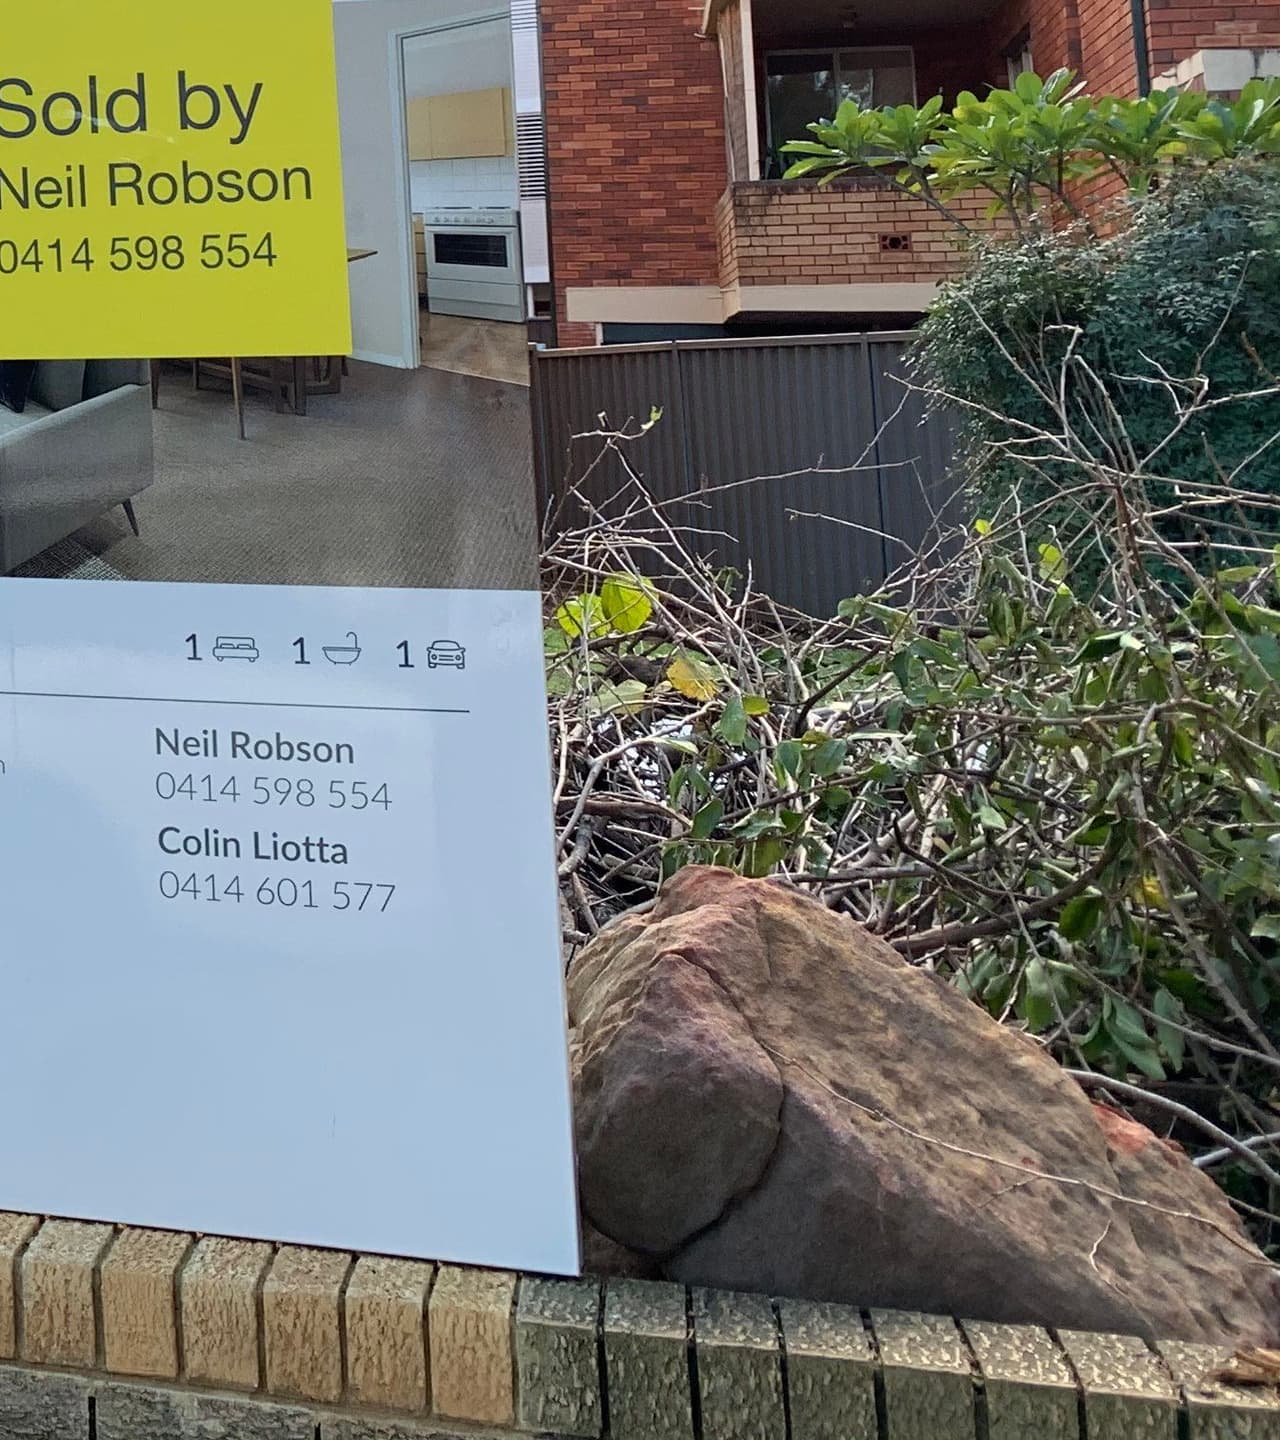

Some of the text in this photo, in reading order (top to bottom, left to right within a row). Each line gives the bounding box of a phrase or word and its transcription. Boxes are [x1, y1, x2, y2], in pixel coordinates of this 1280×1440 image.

[178, 70, 263, 145] by
[109, 160, 311, 206] Robson
[110, 235, 184, 271] 598
[201, 232, 277, 269] 554
[185, 634, 202, 660] 1
[293, 637, 310, 664] 1
[397, 640, 414, 668] 1
[156, 728, 354, 764] Neil Robson
[156, 772, 392, 810] 0414 598 554
[158, 827, 348, 864] Colin Liotta
[159, 871, 395, 912] 0414 601 577
